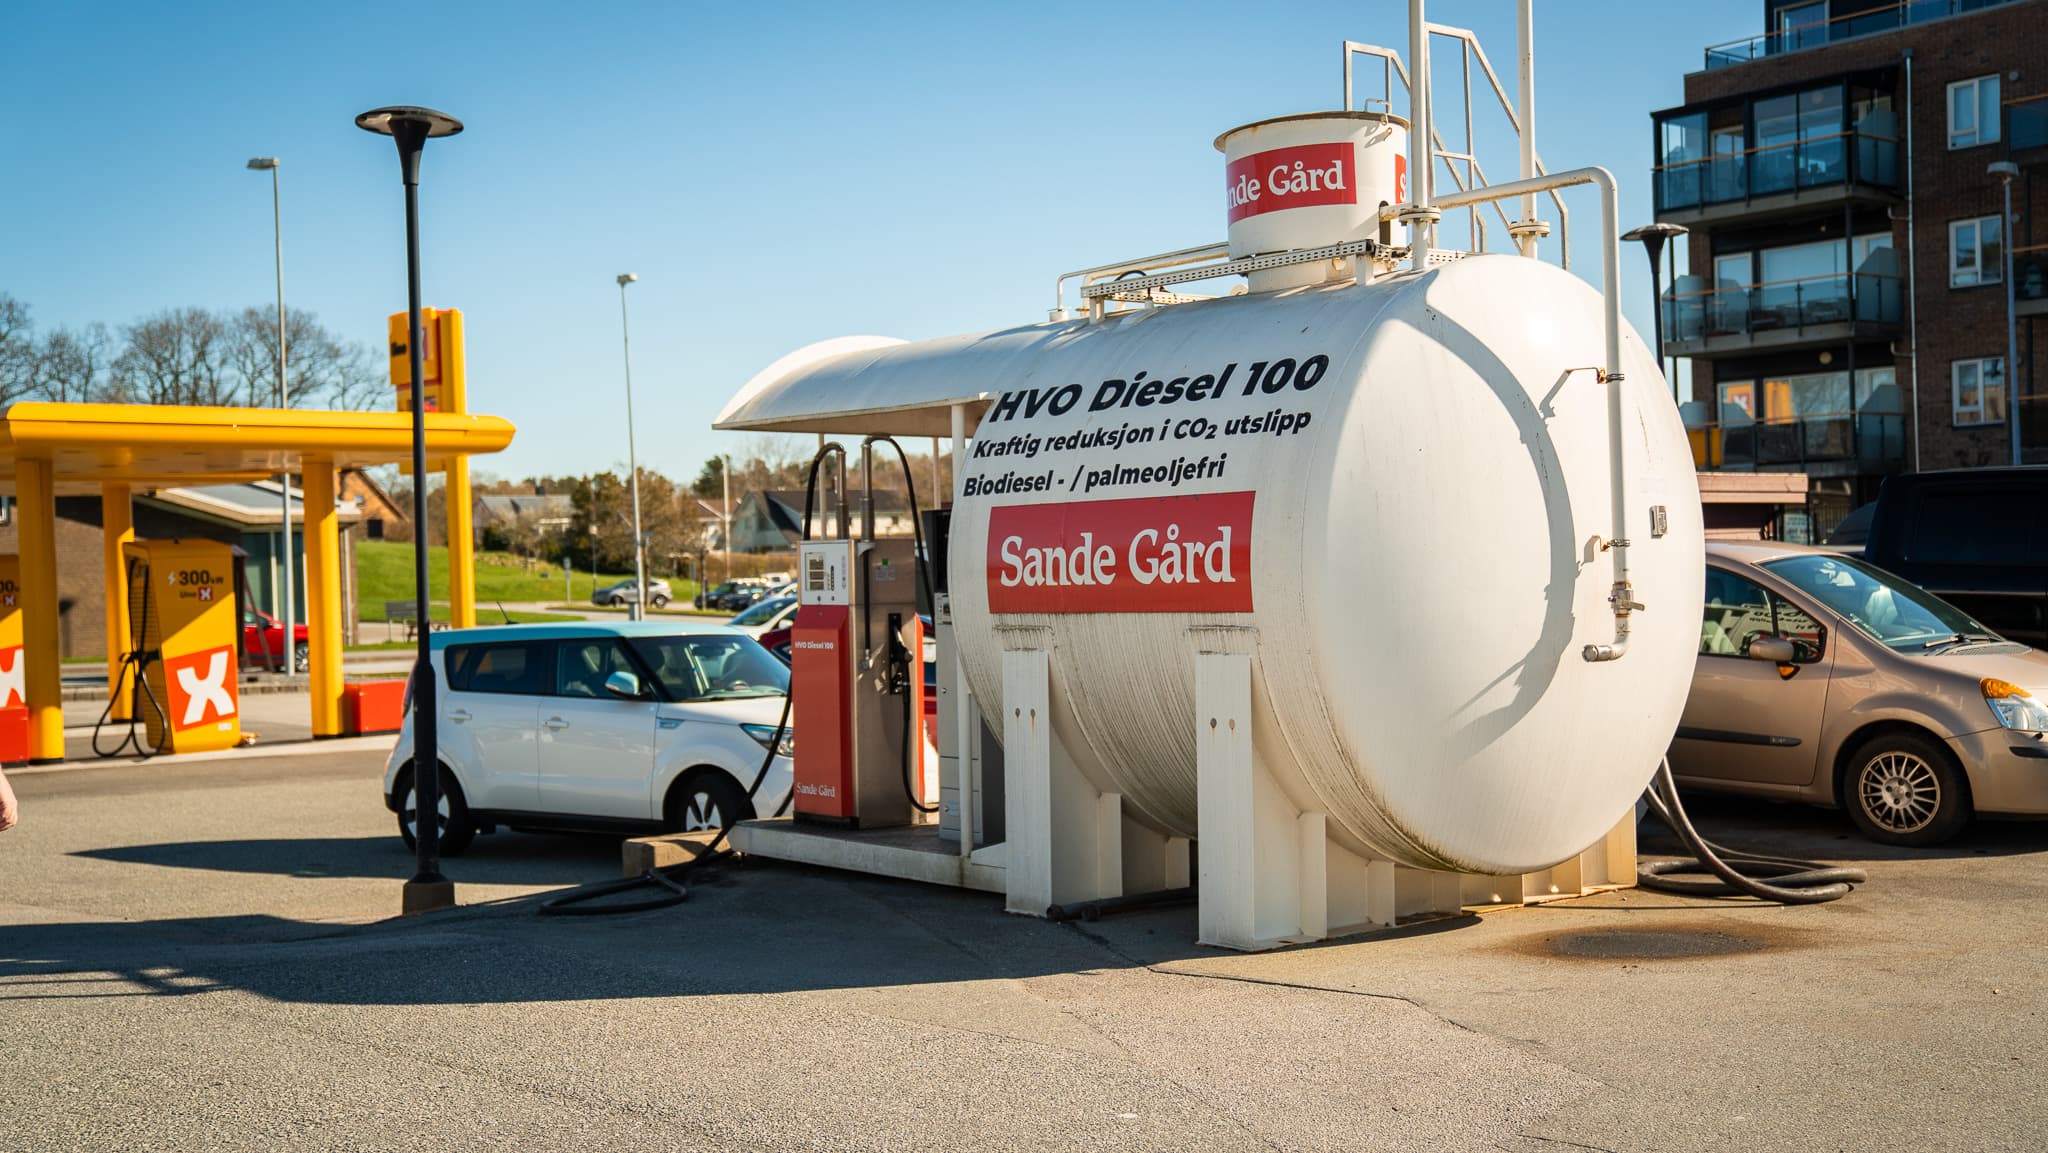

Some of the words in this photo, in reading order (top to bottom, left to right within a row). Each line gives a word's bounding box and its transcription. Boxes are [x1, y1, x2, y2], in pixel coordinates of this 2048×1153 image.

[1227, 175, 1261, 210] nde
[1267, 160, 1347, 195] Gård
[989, 383, 1083, 423] HVO
[1088, 362, 1239, 414] Diesel
[1241, 354, 1330, 396] 100
[973, 432, 1042, 458] Kraftig
[1044, 422, 1155, 450] reduksjon
[1159, 418, 1171, 441] i
[1224, 408, 1312, 436] utslipp
[963, 469, 1054, 497] Biodiesel
[1084, 453, 1227, 493] palmeoljefri
[1000, 531, 1117, 588] Sande
[1128, 523, 1236, 585] Gård
[177, 650, 235, 725] X
